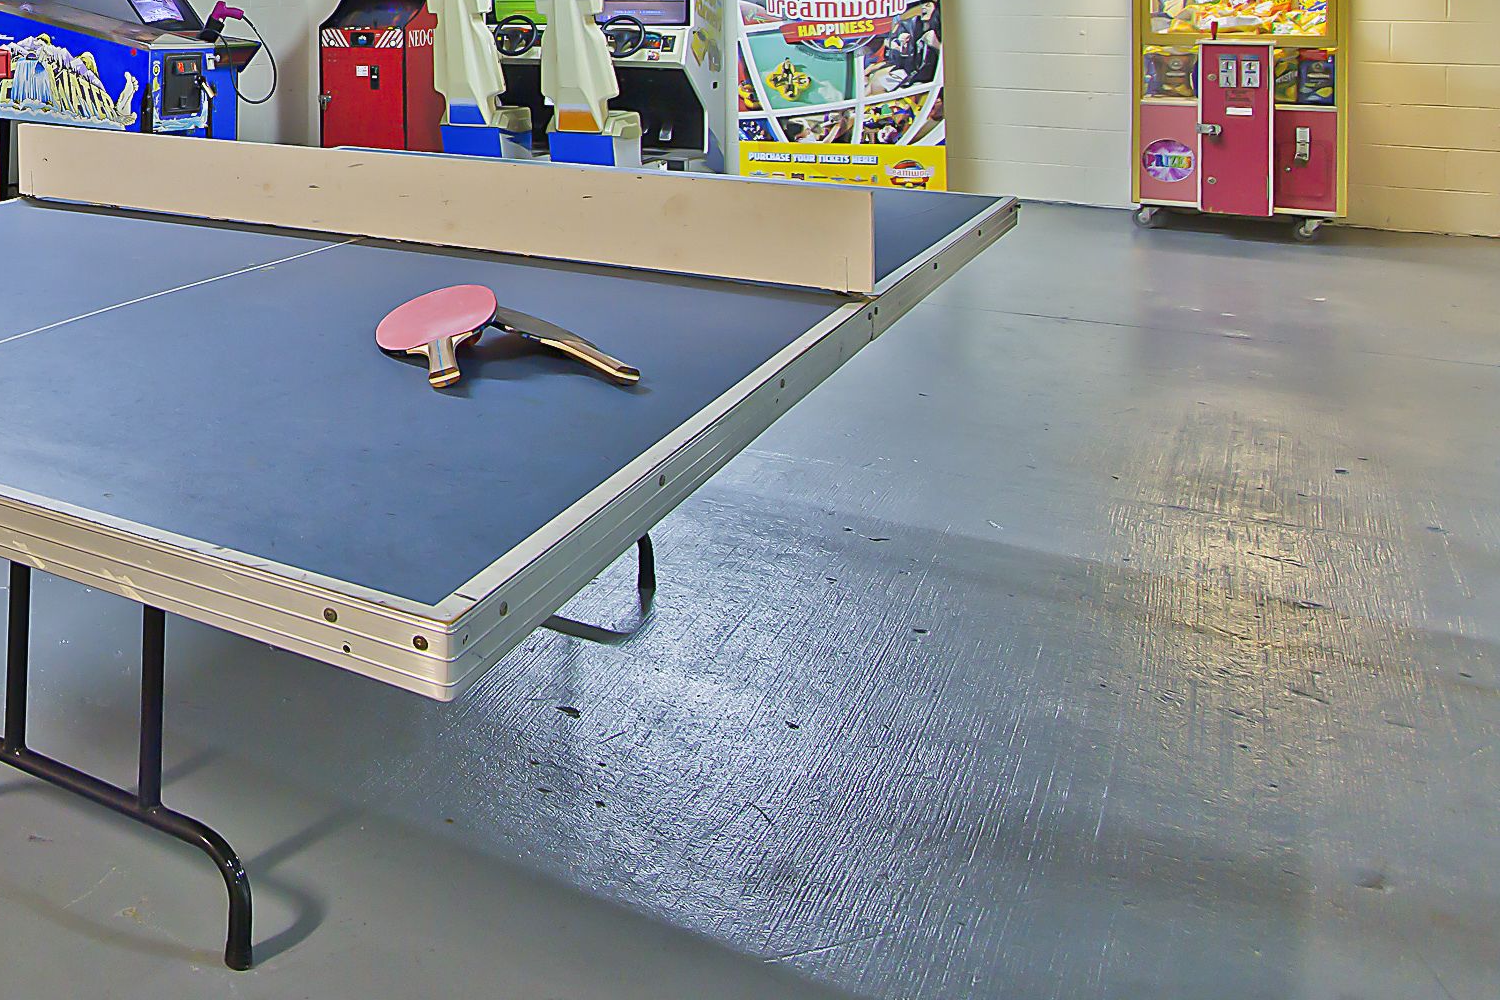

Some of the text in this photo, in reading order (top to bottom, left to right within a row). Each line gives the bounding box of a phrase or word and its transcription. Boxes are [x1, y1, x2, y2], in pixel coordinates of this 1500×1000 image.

[797, 19, 875, 38] HAPPINESS
[748, 152, 791, 162] PURCHASE
[792, 153, 816, 163] YOUR
[818, 154, 850, 164] TICKETS
